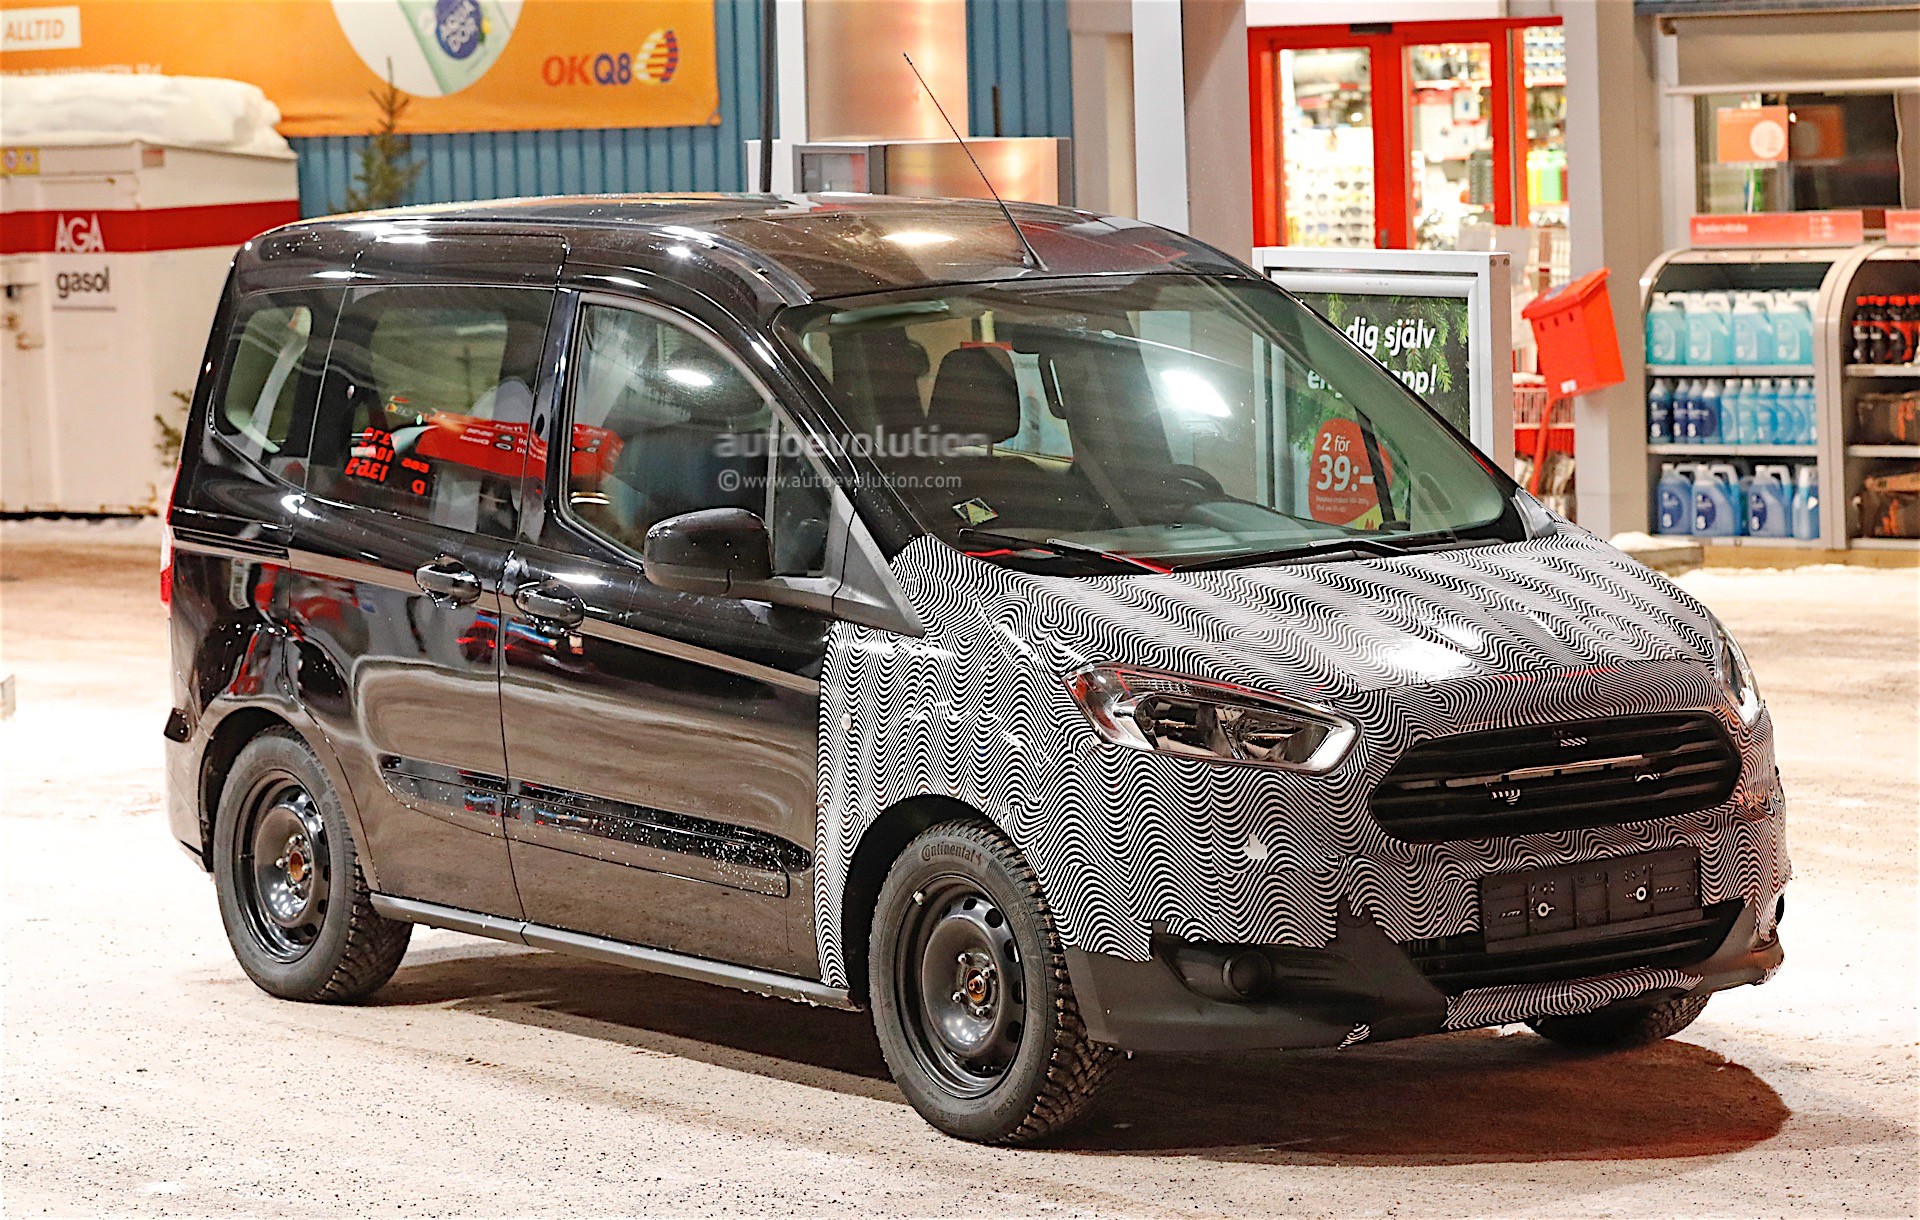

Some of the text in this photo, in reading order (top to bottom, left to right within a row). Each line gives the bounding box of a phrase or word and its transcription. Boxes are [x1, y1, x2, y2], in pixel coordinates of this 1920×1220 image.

[6, 18, 64, 41] ALLTID
[541, 52, 631, 86] OKQ8
[55, 212, 106, 253] AGA
[56, 264, 110, 299] gasol
[1345, 316, 1437, 356] dig själv
[1321, 432, 1351, 452] 2 för
[921, 841, 976, 862] Continental
